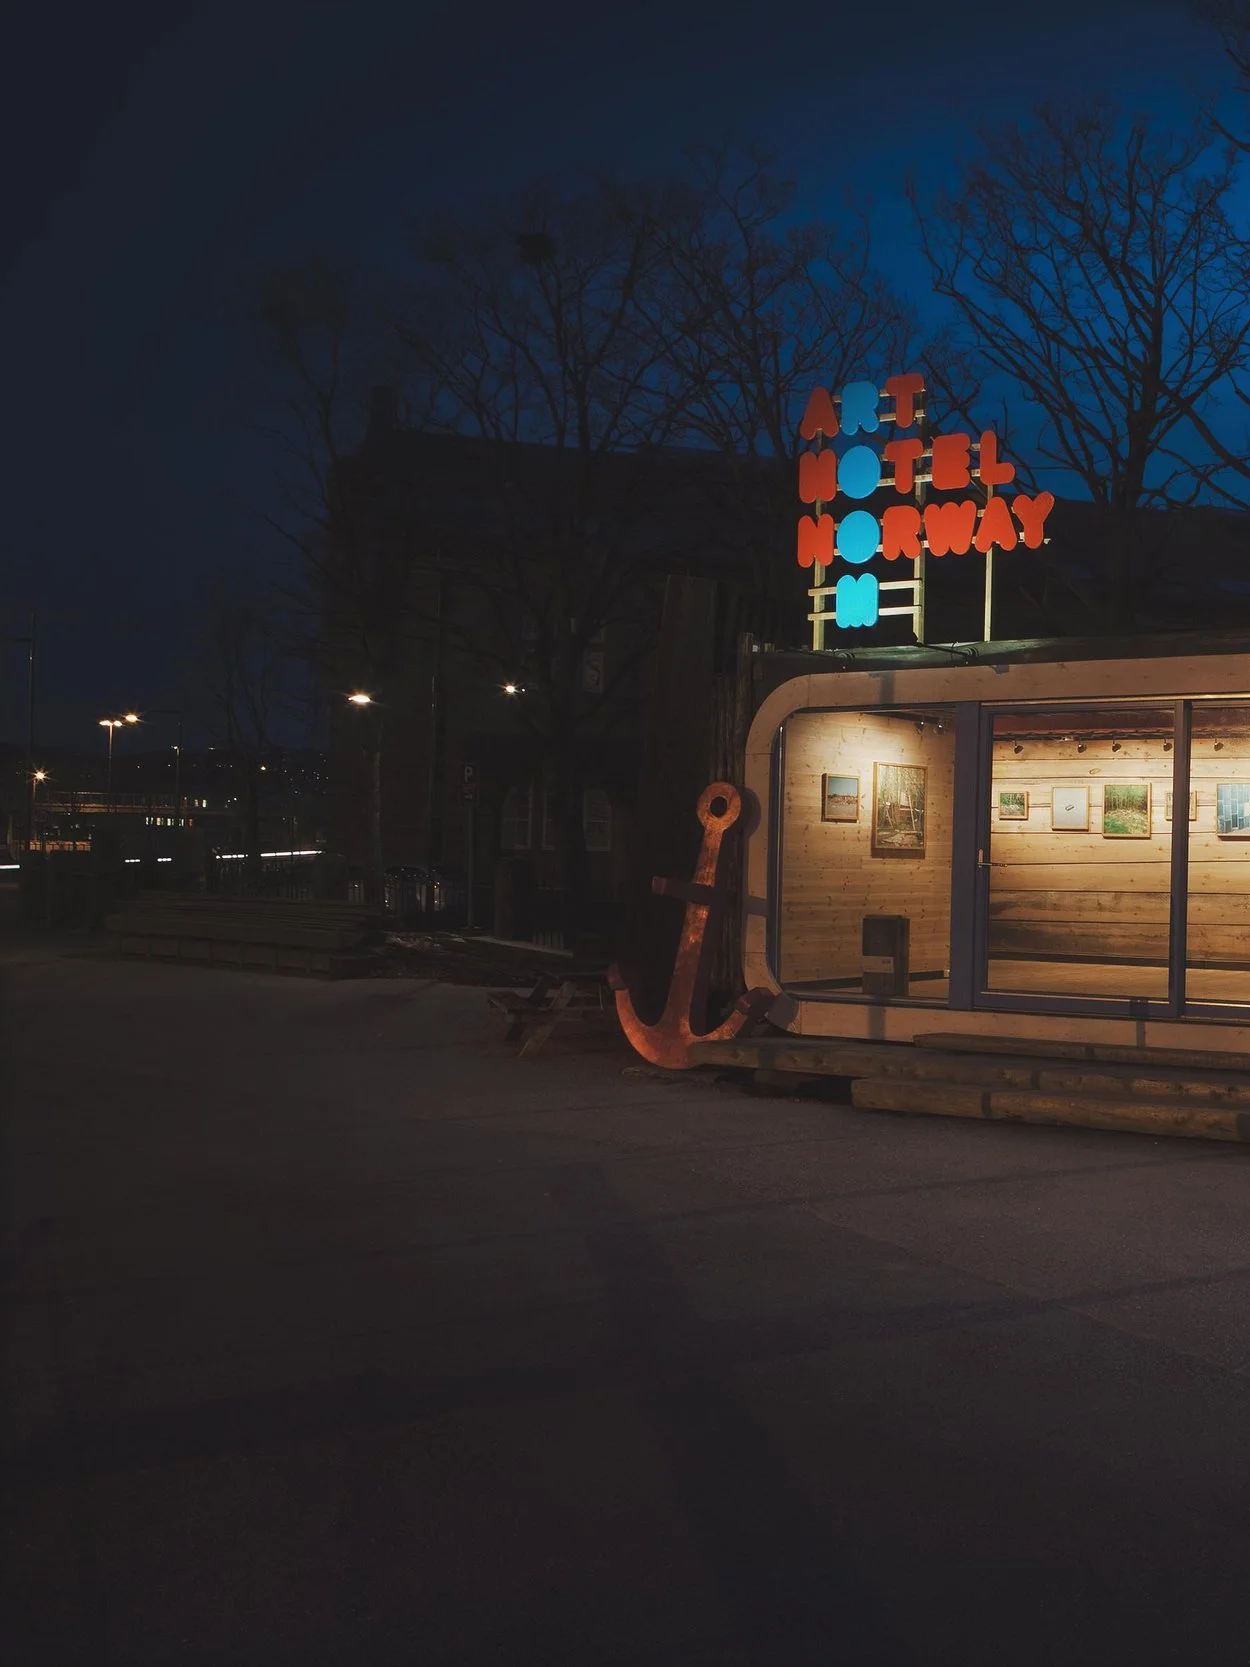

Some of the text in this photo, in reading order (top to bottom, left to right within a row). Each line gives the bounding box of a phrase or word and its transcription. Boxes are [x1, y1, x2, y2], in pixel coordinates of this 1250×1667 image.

[800, 373, 925, 440] ART
[799, 430, 1016, 504] HOTEL
[797, 491, 1055, 568] NORWAY
